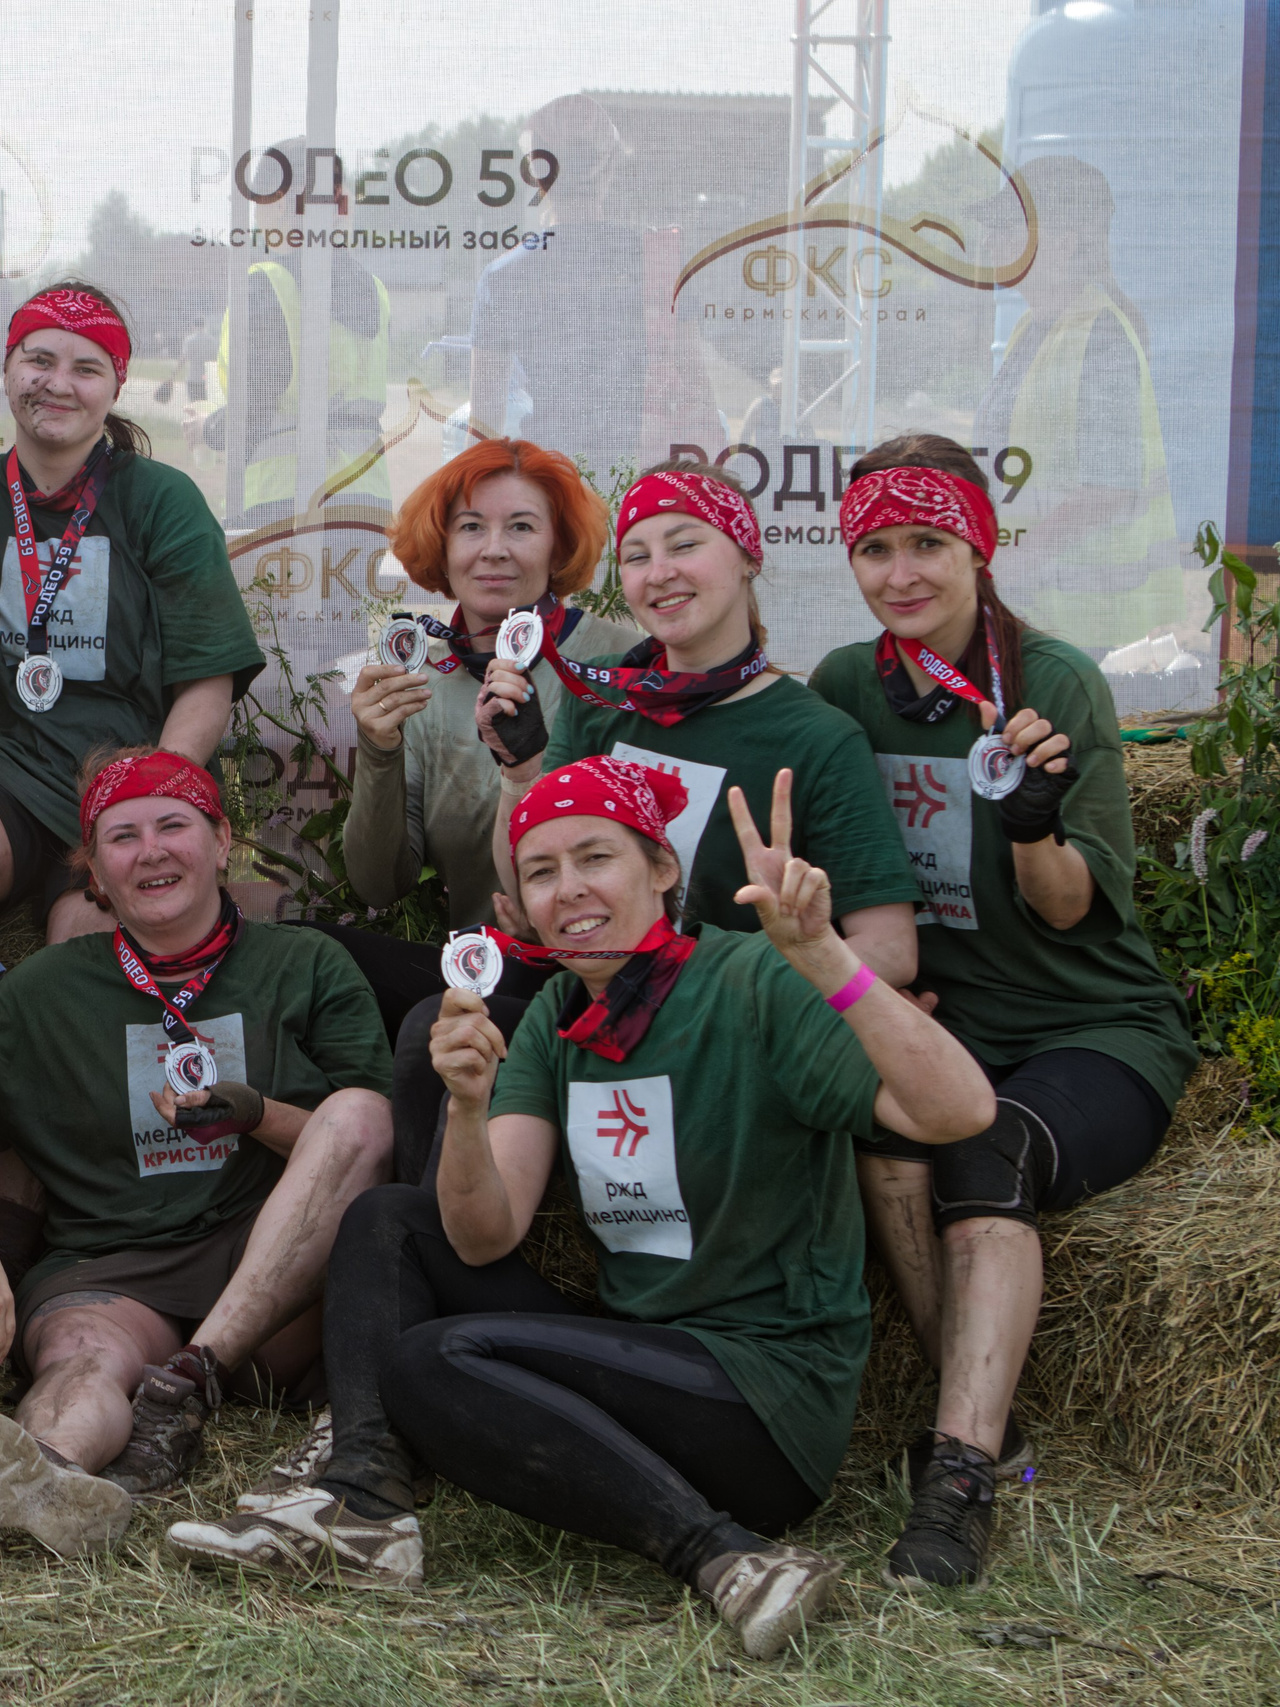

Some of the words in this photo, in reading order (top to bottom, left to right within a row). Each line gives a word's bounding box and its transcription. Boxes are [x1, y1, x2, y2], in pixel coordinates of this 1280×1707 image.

[191, 147, 453, 215] РОДЕО
[477, 149, 560, 207] 59
[190, 225, 450, 253] экстремальный
[462, 225, 555, 250] забег
[743, 245, 892, 298] ФКС
[704, 304, 846, 321] Пермский
[862, 307, 926, 323] край
[10, 480, 30, 534] РОДЕО
[20, 537, 34, 556] 59
[31, 569, 63, 626] РОДЕО
[55, 546, 72, 565] 59
[256, 547, 408, 600] ФКС
[587, 668, 610, 683] 59
[918, 648, 954, 680] РОДЕО
[946, 676, 968, 689] 59
[909, 852, 937, 871] жд
[118, 941, 148, 985] РОДЕО
[172, 990, 193, 1008] 59
[143, 1143, 234, 1168] КРИСТИН
[605, 1182, 648, 1202] ржд
[585, 1209, 688, 1225] медицина
[151, 1377, 177, 1394] PULSE
